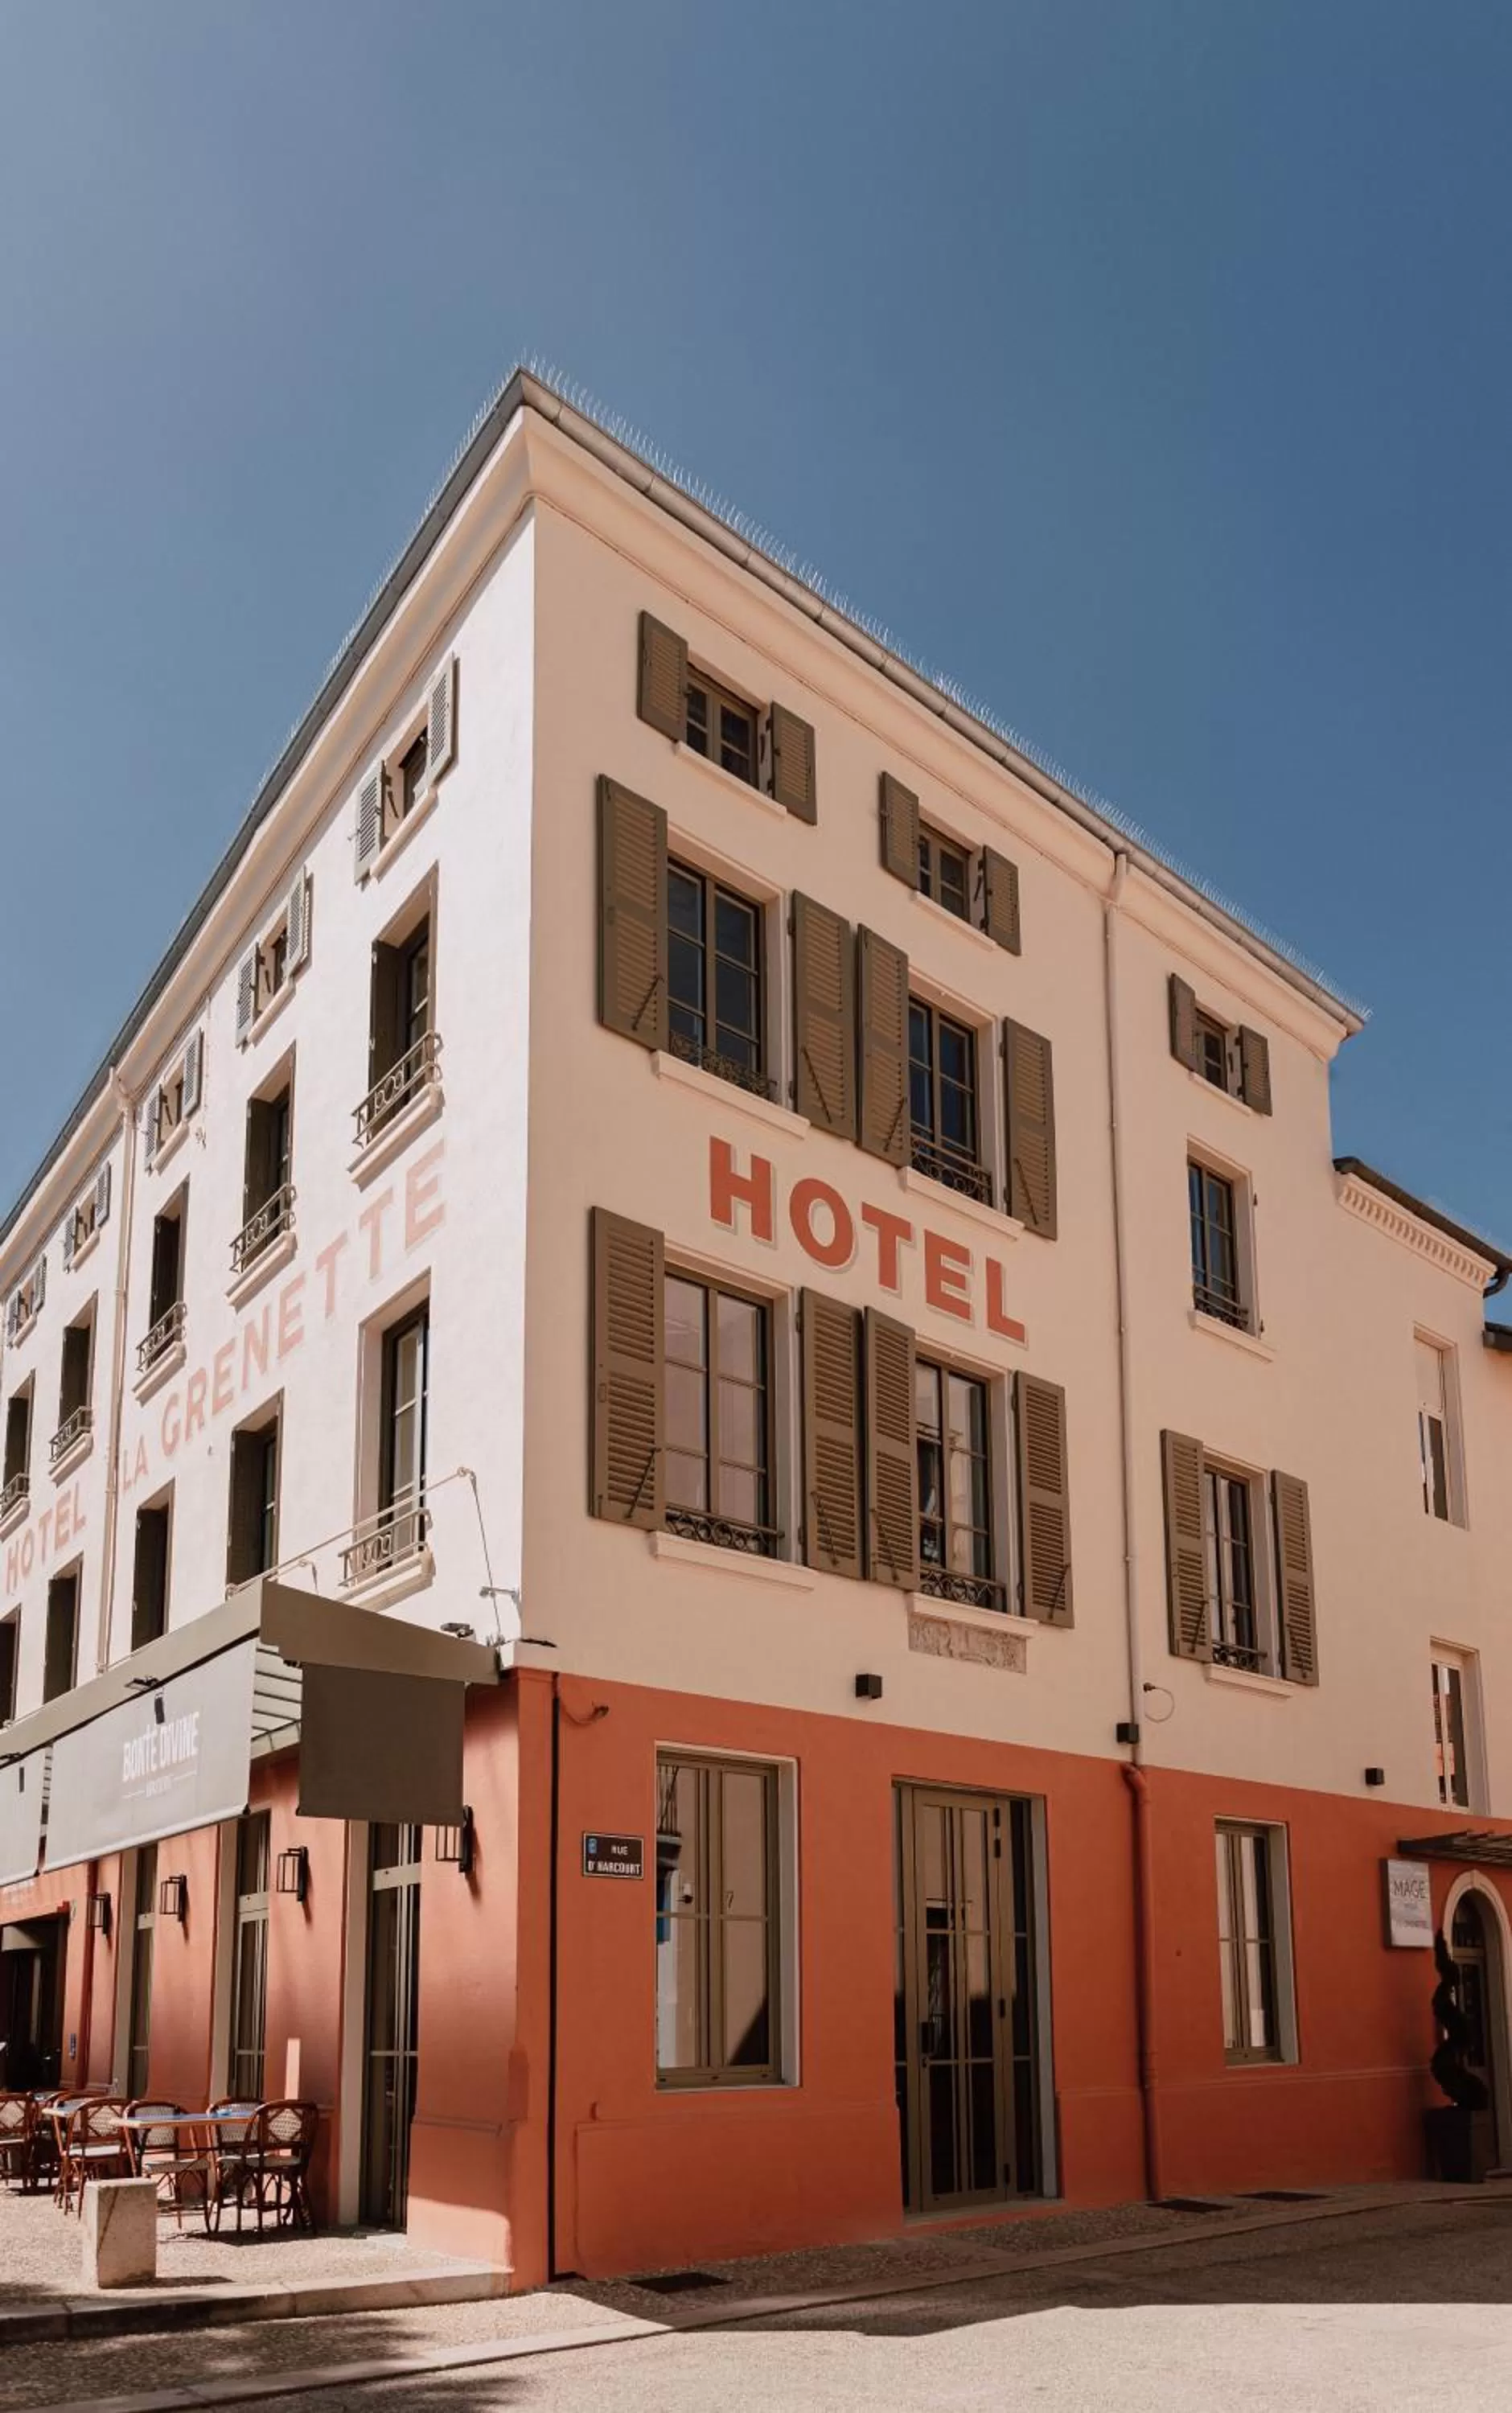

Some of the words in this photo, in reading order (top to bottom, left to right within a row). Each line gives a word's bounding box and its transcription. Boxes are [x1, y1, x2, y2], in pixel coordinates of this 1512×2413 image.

[709, 1135, 1027, 1346] HOTEL
[6, 1480, 86, 1596] HOTEL
[123, 1434, 148, 1495] LA
[162, 1138, 446, 1456] GRENETTE
[611, 1845, 628, 1855] RUE
